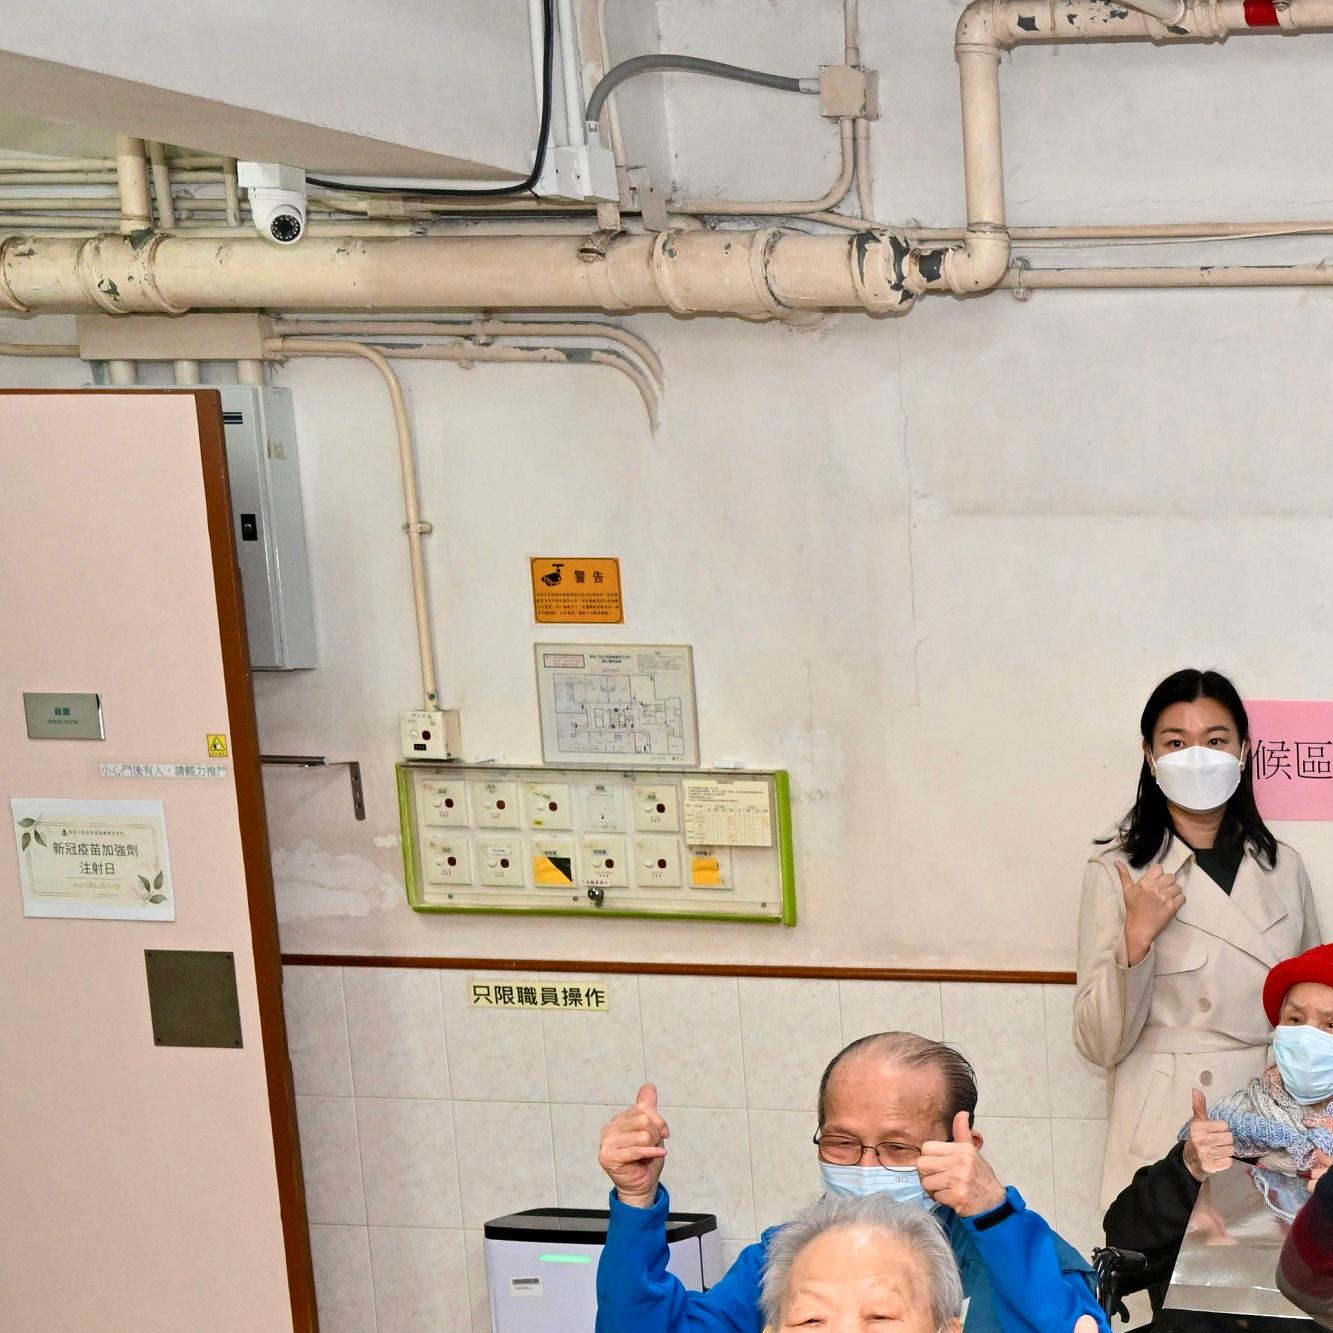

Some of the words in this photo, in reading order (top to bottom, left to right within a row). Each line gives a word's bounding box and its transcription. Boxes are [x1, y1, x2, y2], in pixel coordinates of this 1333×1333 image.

[1252, 739, 1333, 780] 候區
[53, 842, 139, 857] 新冠疫苗加強劑
[79, 862, 116, 875] 注射日
[472, 985, 606, 1008] 只限職員操作
